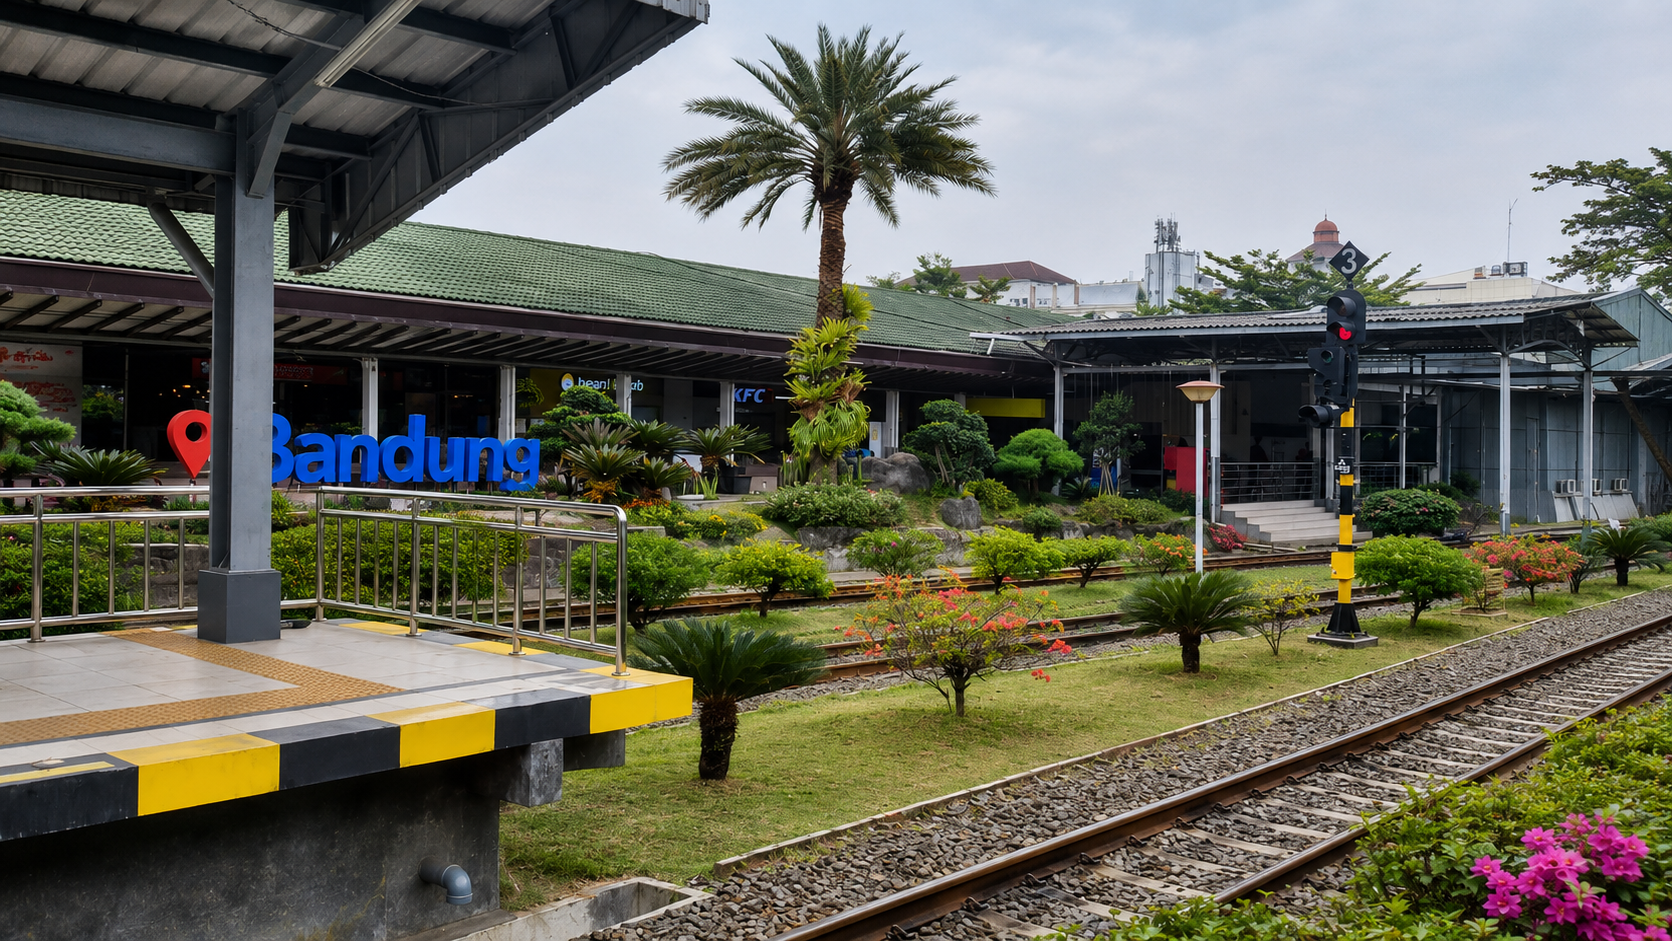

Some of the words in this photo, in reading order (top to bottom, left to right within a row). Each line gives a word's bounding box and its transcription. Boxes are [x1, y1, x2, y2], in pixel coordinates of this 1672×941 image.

[1341, 248, 1357, 274] 3
[734, 388, 766, 403] KFC
[272, 413, 540, 492] Bandung
